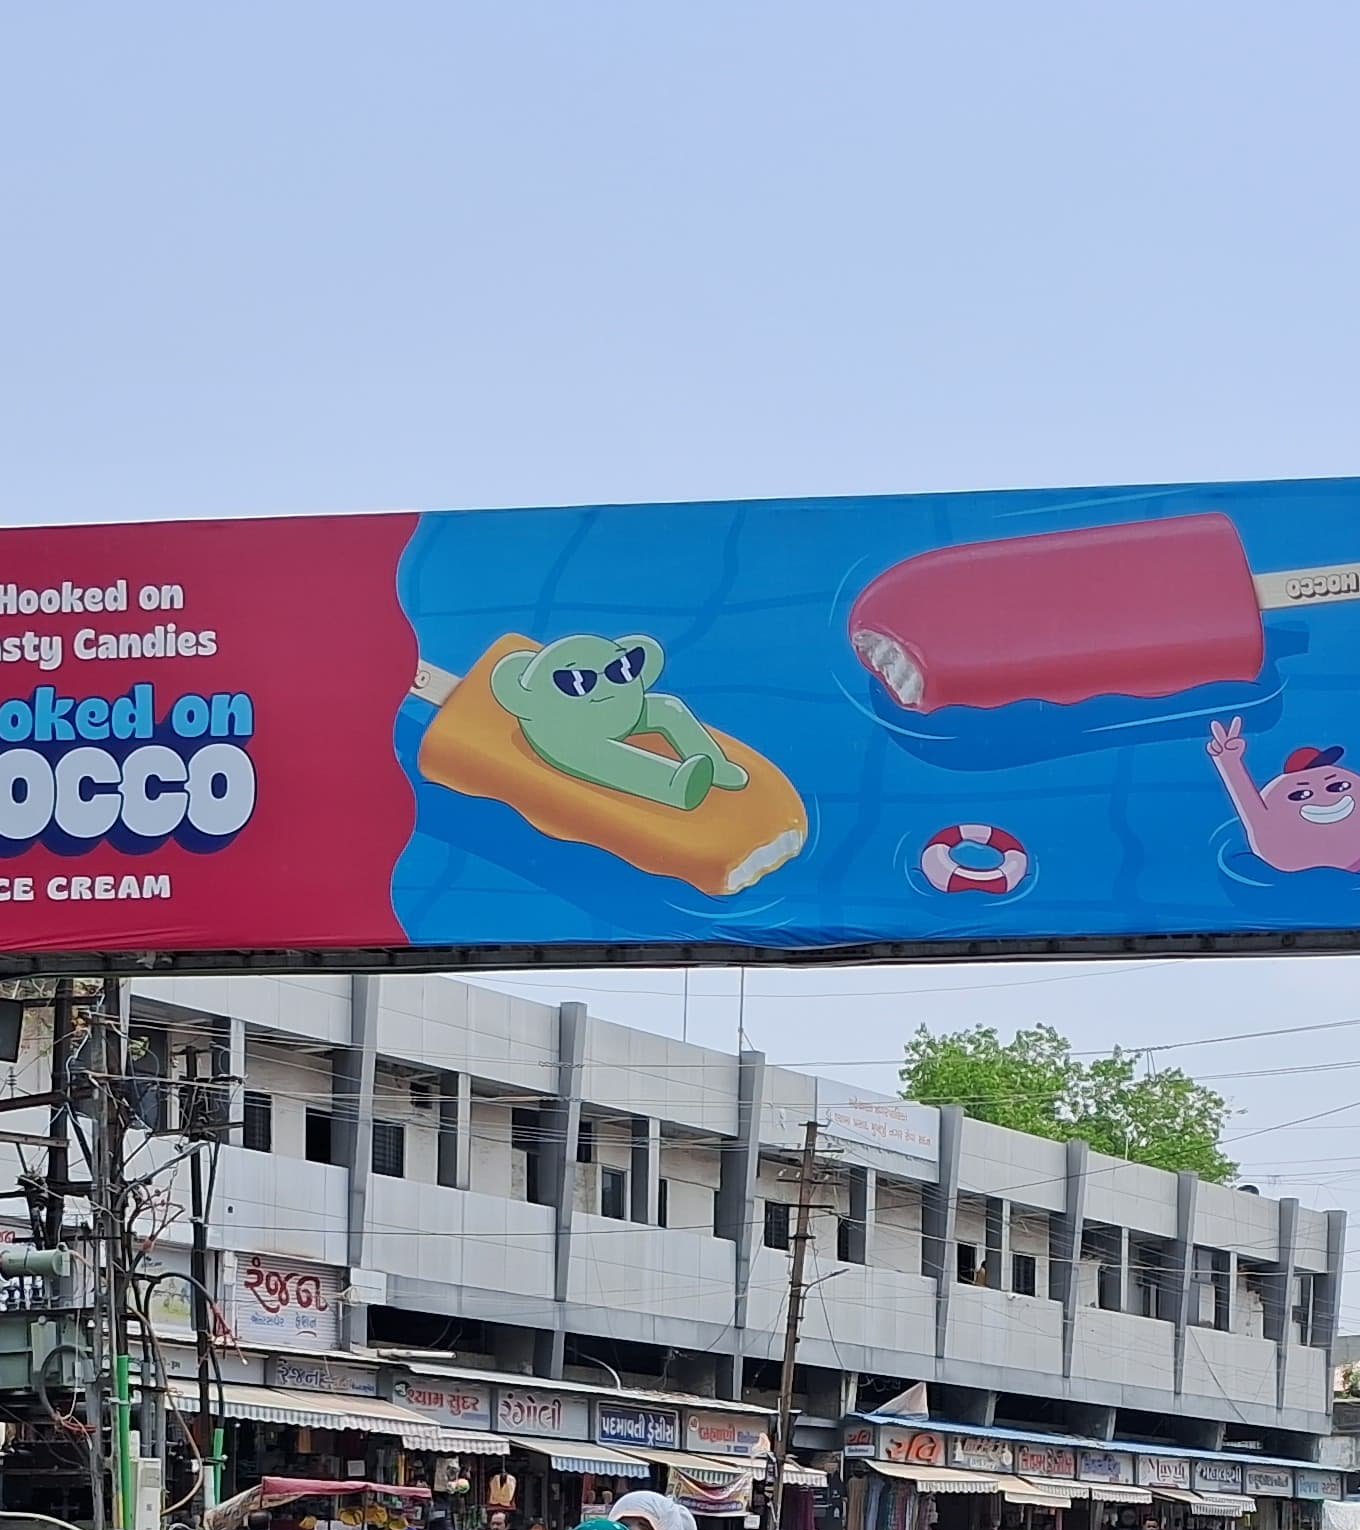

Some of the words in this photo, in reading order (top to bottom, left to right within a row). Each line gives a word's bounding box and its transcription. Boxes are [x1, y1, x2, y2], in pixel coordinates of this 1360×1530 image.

[139, 580, 184, 611] on
[73, 624, 217, 661] Candies
[172, 691, 254, 739] on
[47, 874, 171, 901] CREAM
